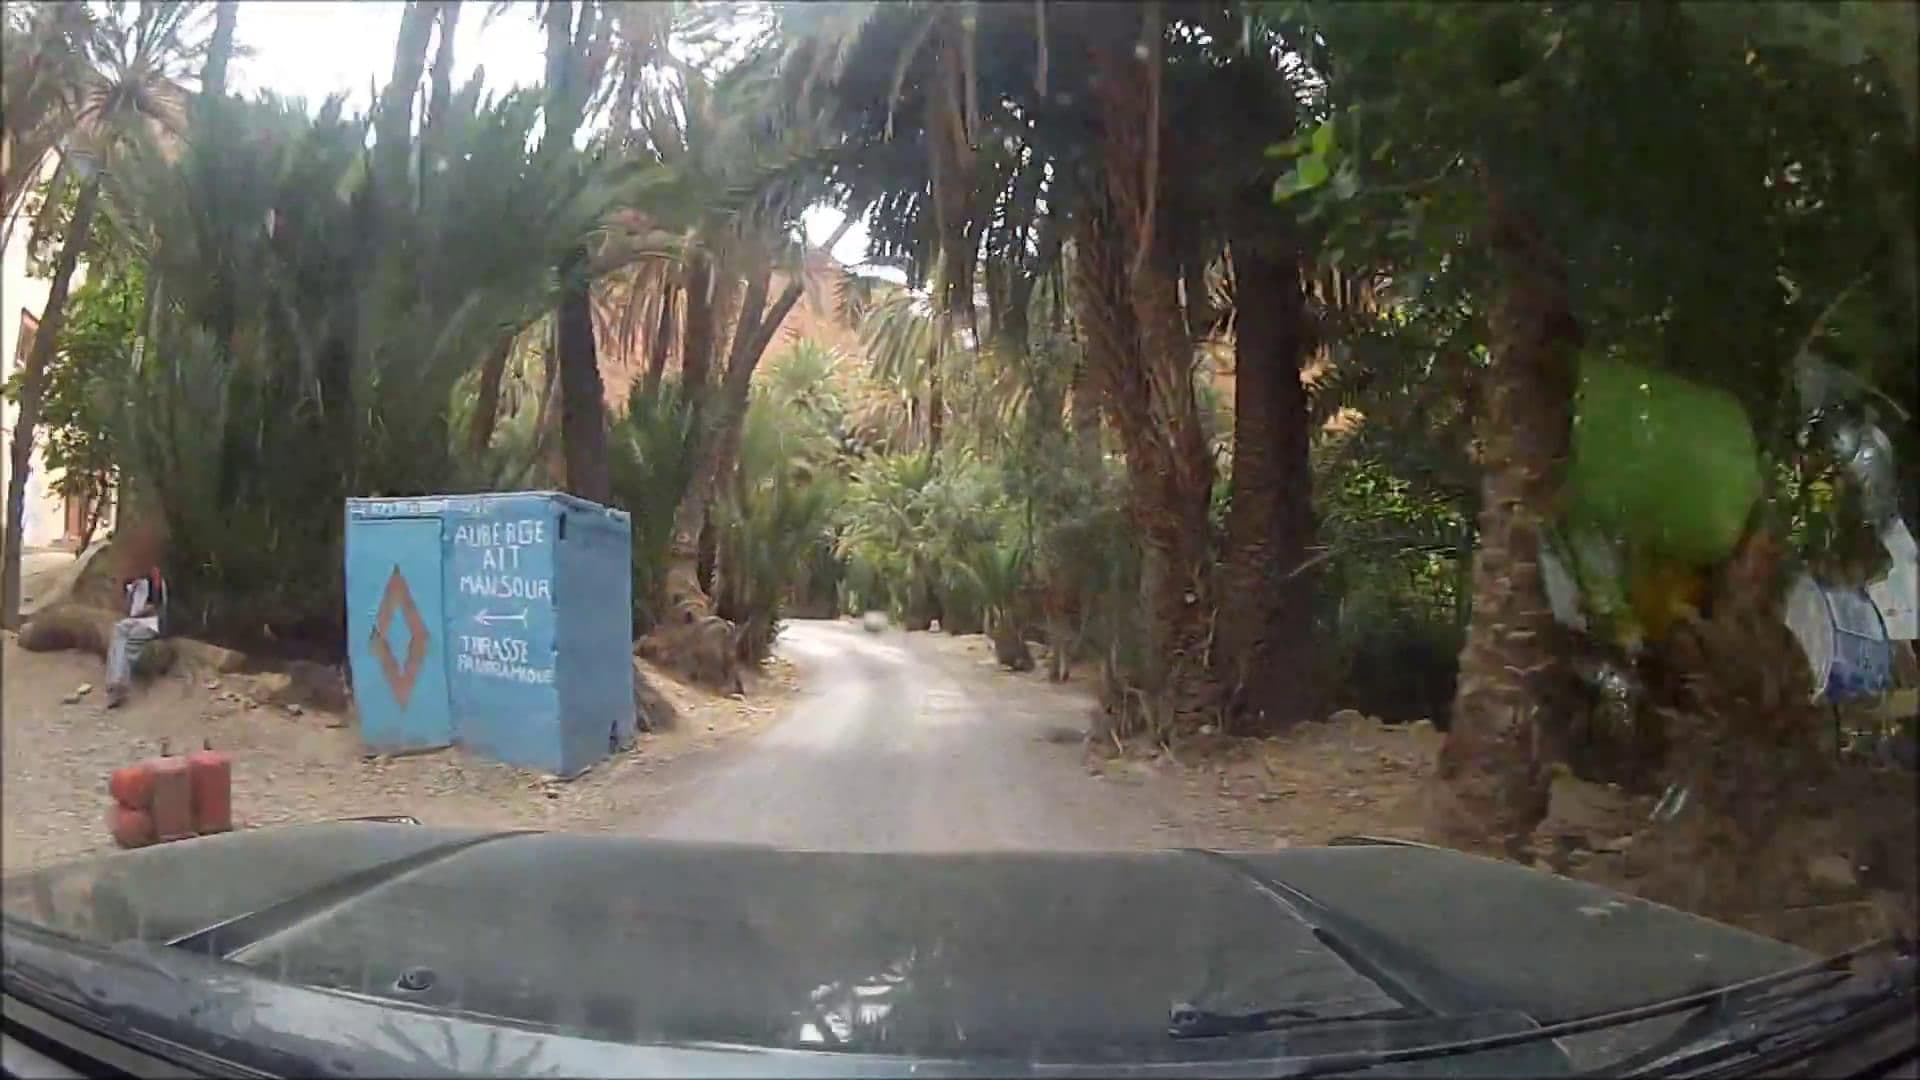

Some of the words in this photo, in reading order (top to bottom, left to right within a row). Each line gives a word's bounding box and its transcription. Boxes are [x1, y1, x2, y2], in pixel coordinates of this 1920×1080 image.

[455, 520, 545, 547] AUBERGE
[483, 545, 521, 571] AIT
[460, 575, 551, 600] MANSOUR
